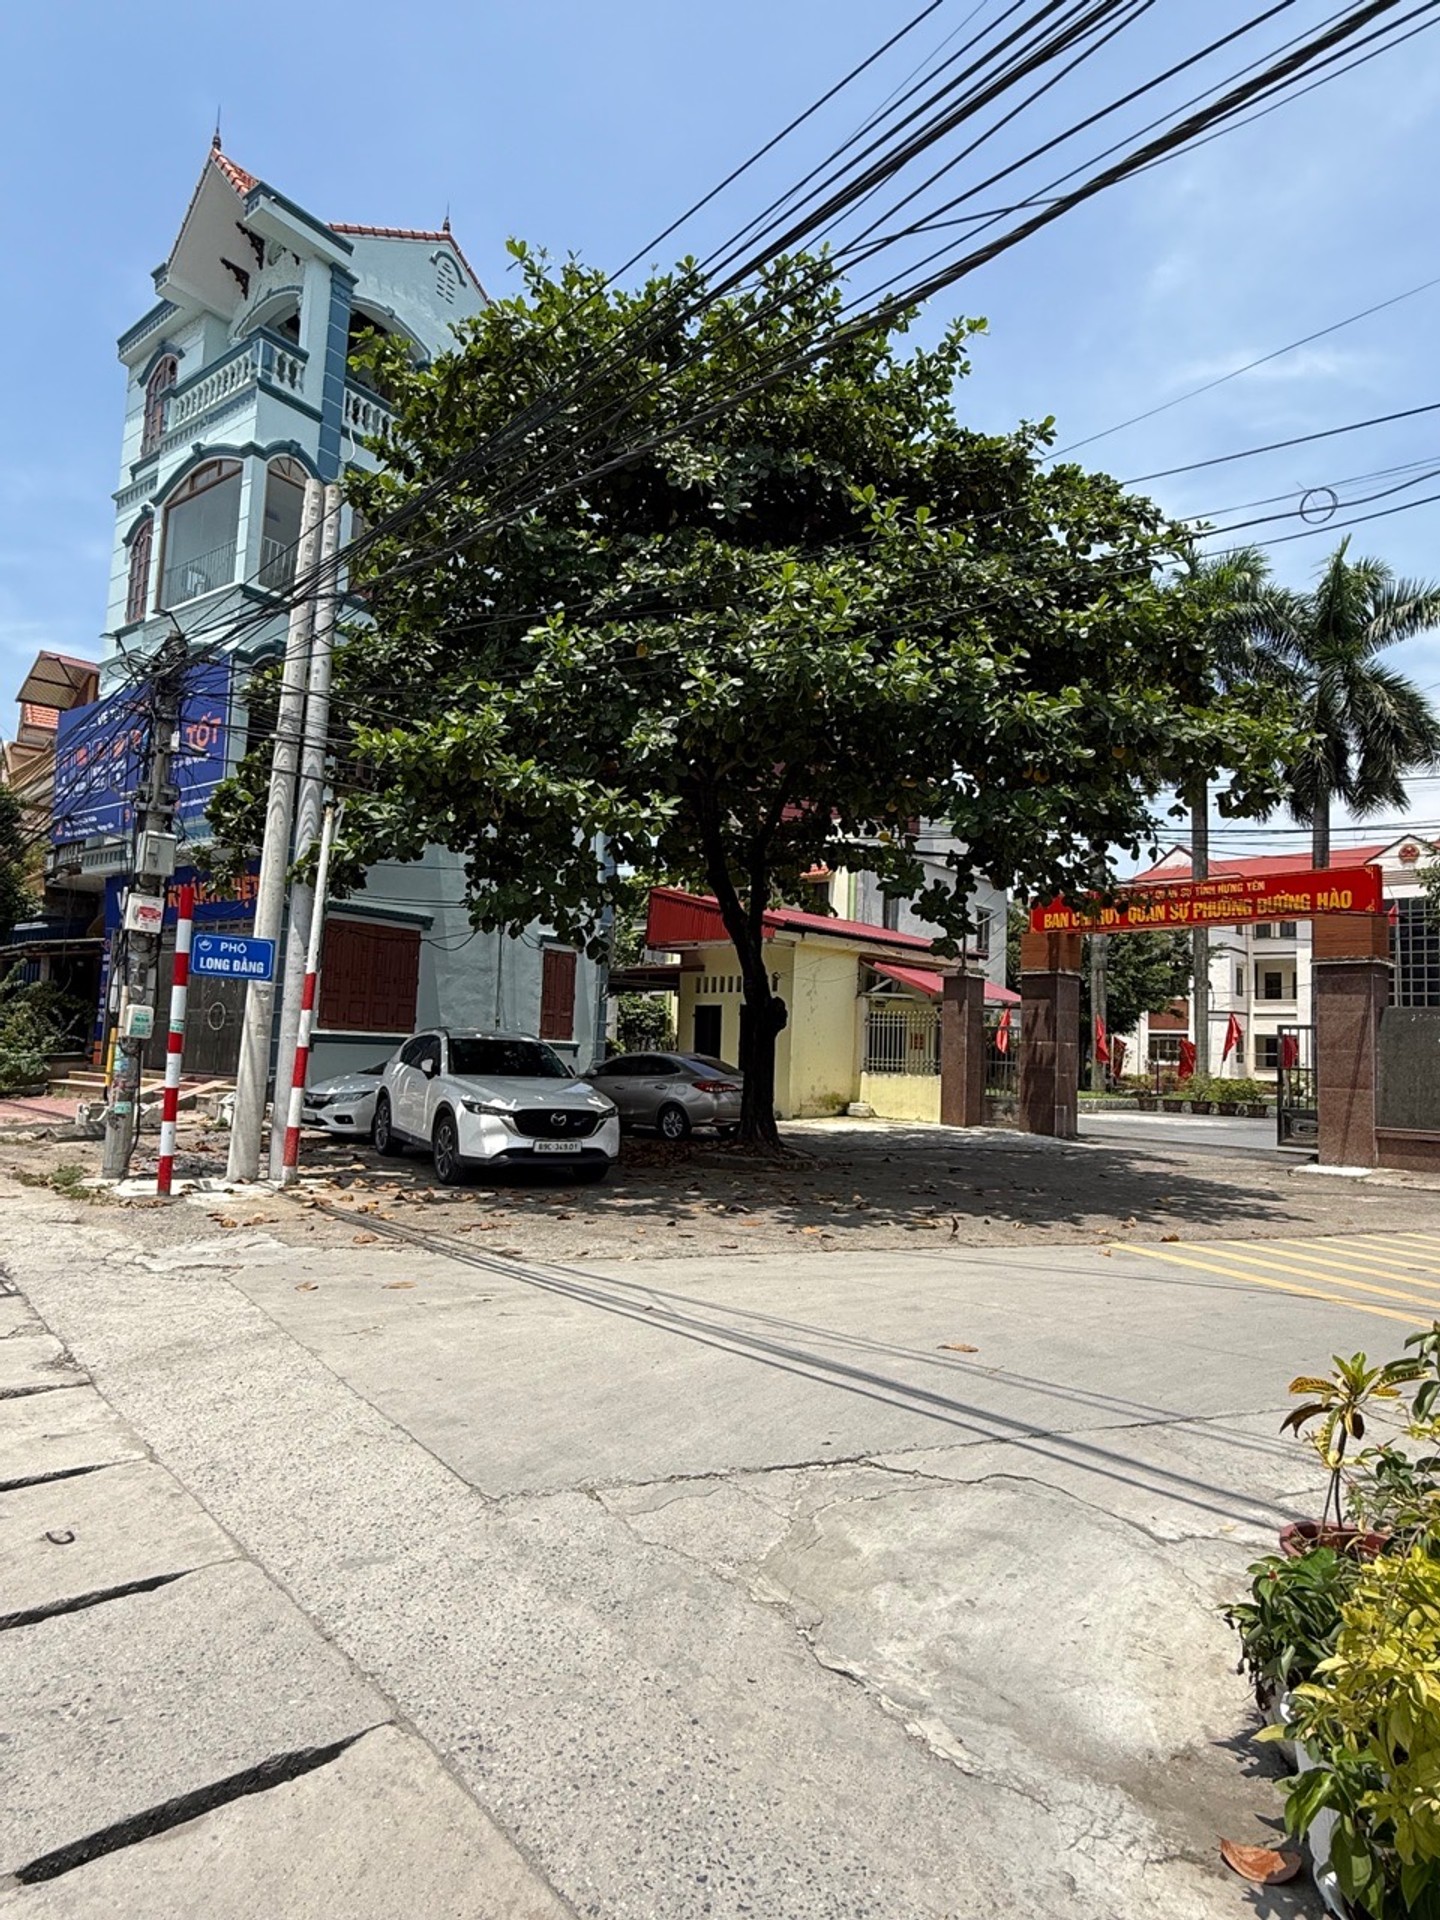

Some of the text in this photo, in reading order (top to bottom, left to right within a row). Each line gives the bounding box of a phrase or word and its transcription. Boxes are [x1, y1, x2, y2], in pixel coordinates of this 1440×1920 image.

[1246, 879, 1266, 892] YÊN
[1044, 912, 1069, 929] BAN
[1169, 901, 1191, 922] SỰ
[1317, 887, 1353, 911] HÀO
[200, 956, 231, 971] LONG
